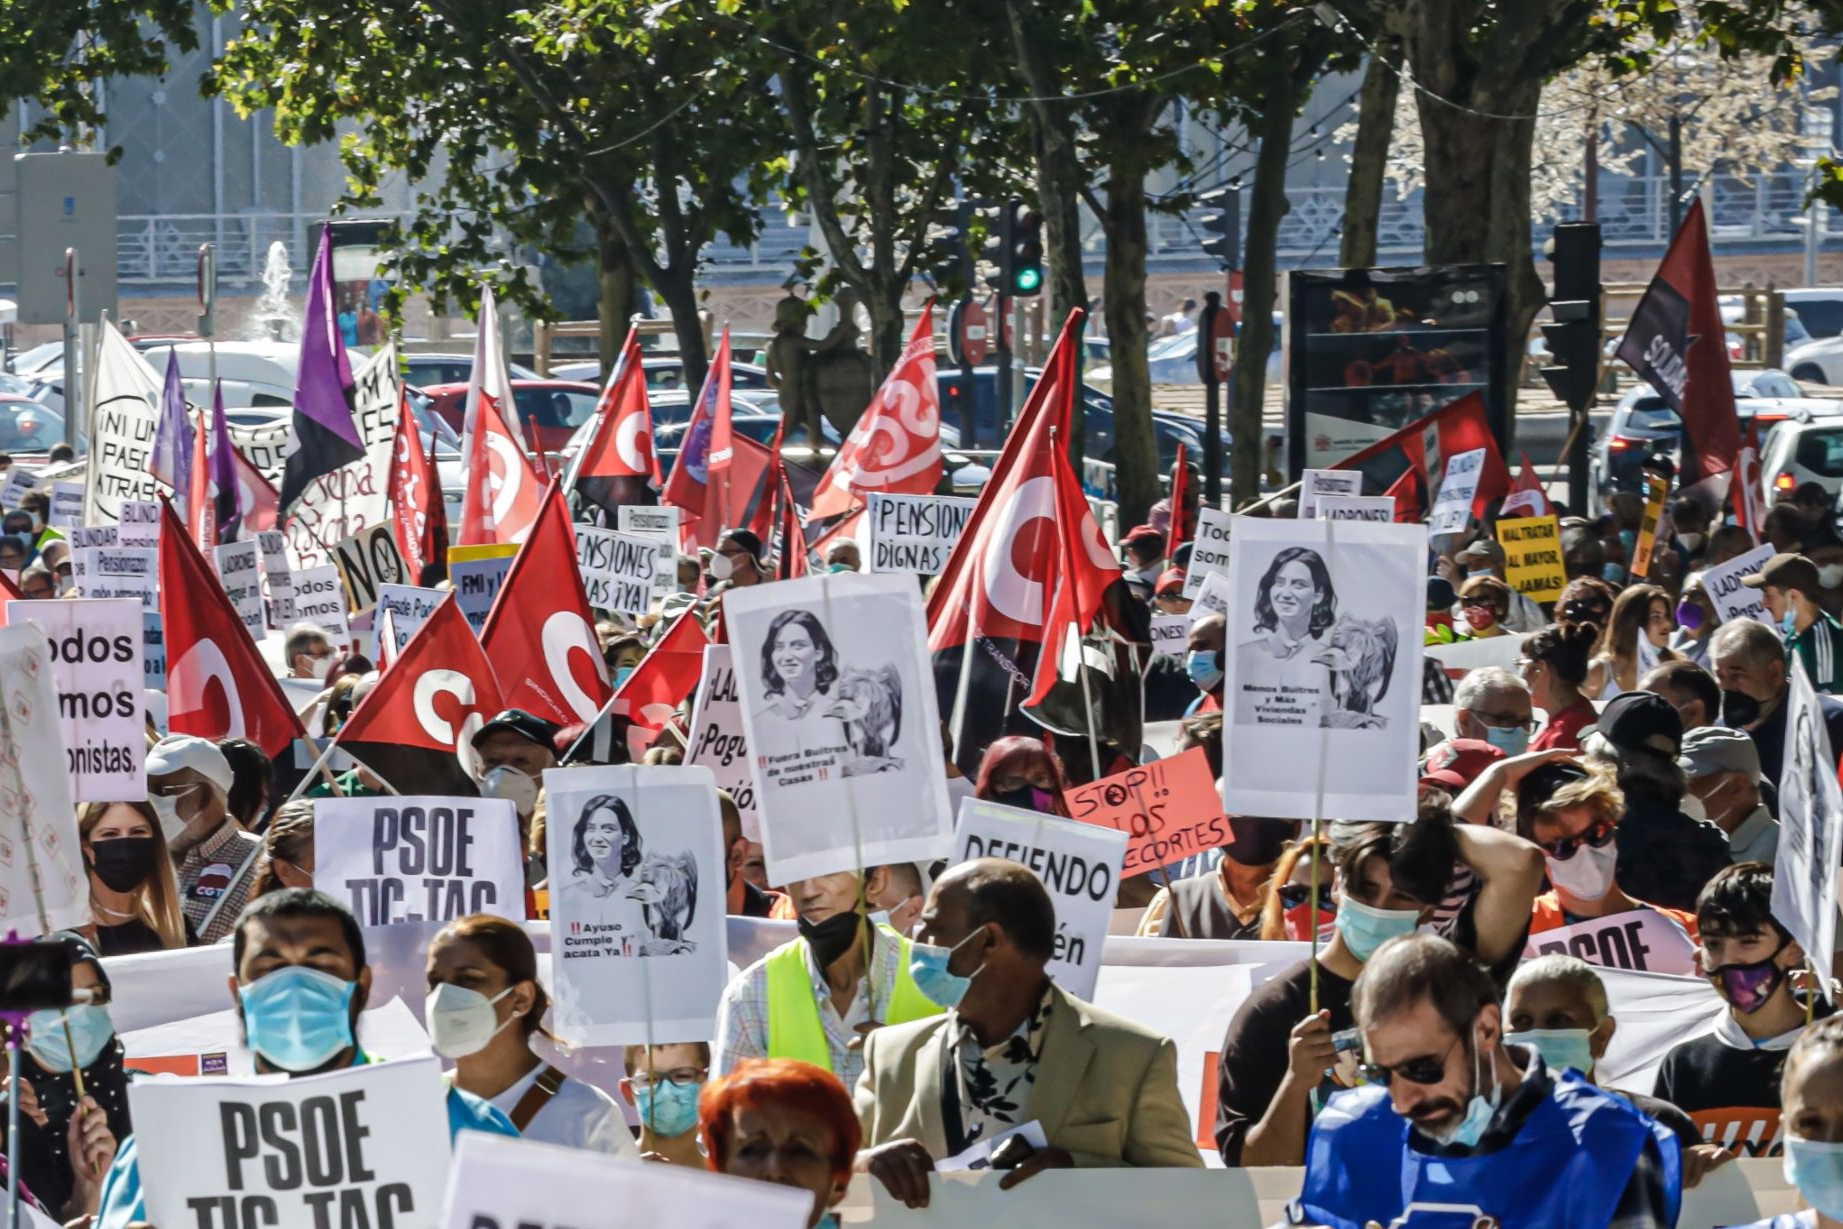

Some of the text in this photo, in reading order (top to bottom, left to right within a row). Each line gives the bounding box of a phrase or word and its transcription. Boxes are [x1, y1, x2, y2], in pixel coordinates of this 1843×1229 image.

[338, 527, 403, 610] NO
[1282, 684, 1320, 694] Buitres
[1254, 705, 1306, 715] Viviendas
[1257, 716, 1302, 725] Sociales
[806, 744, 848, 758] Buitres
[767, 756, 835, 777] de nuestras
[779, 775, 813, 786] Casas
[373, 806, 474, 877] PSOE
[564, 949, 600, 958] acata
[218, 1090, 375, 1191] PSOE
